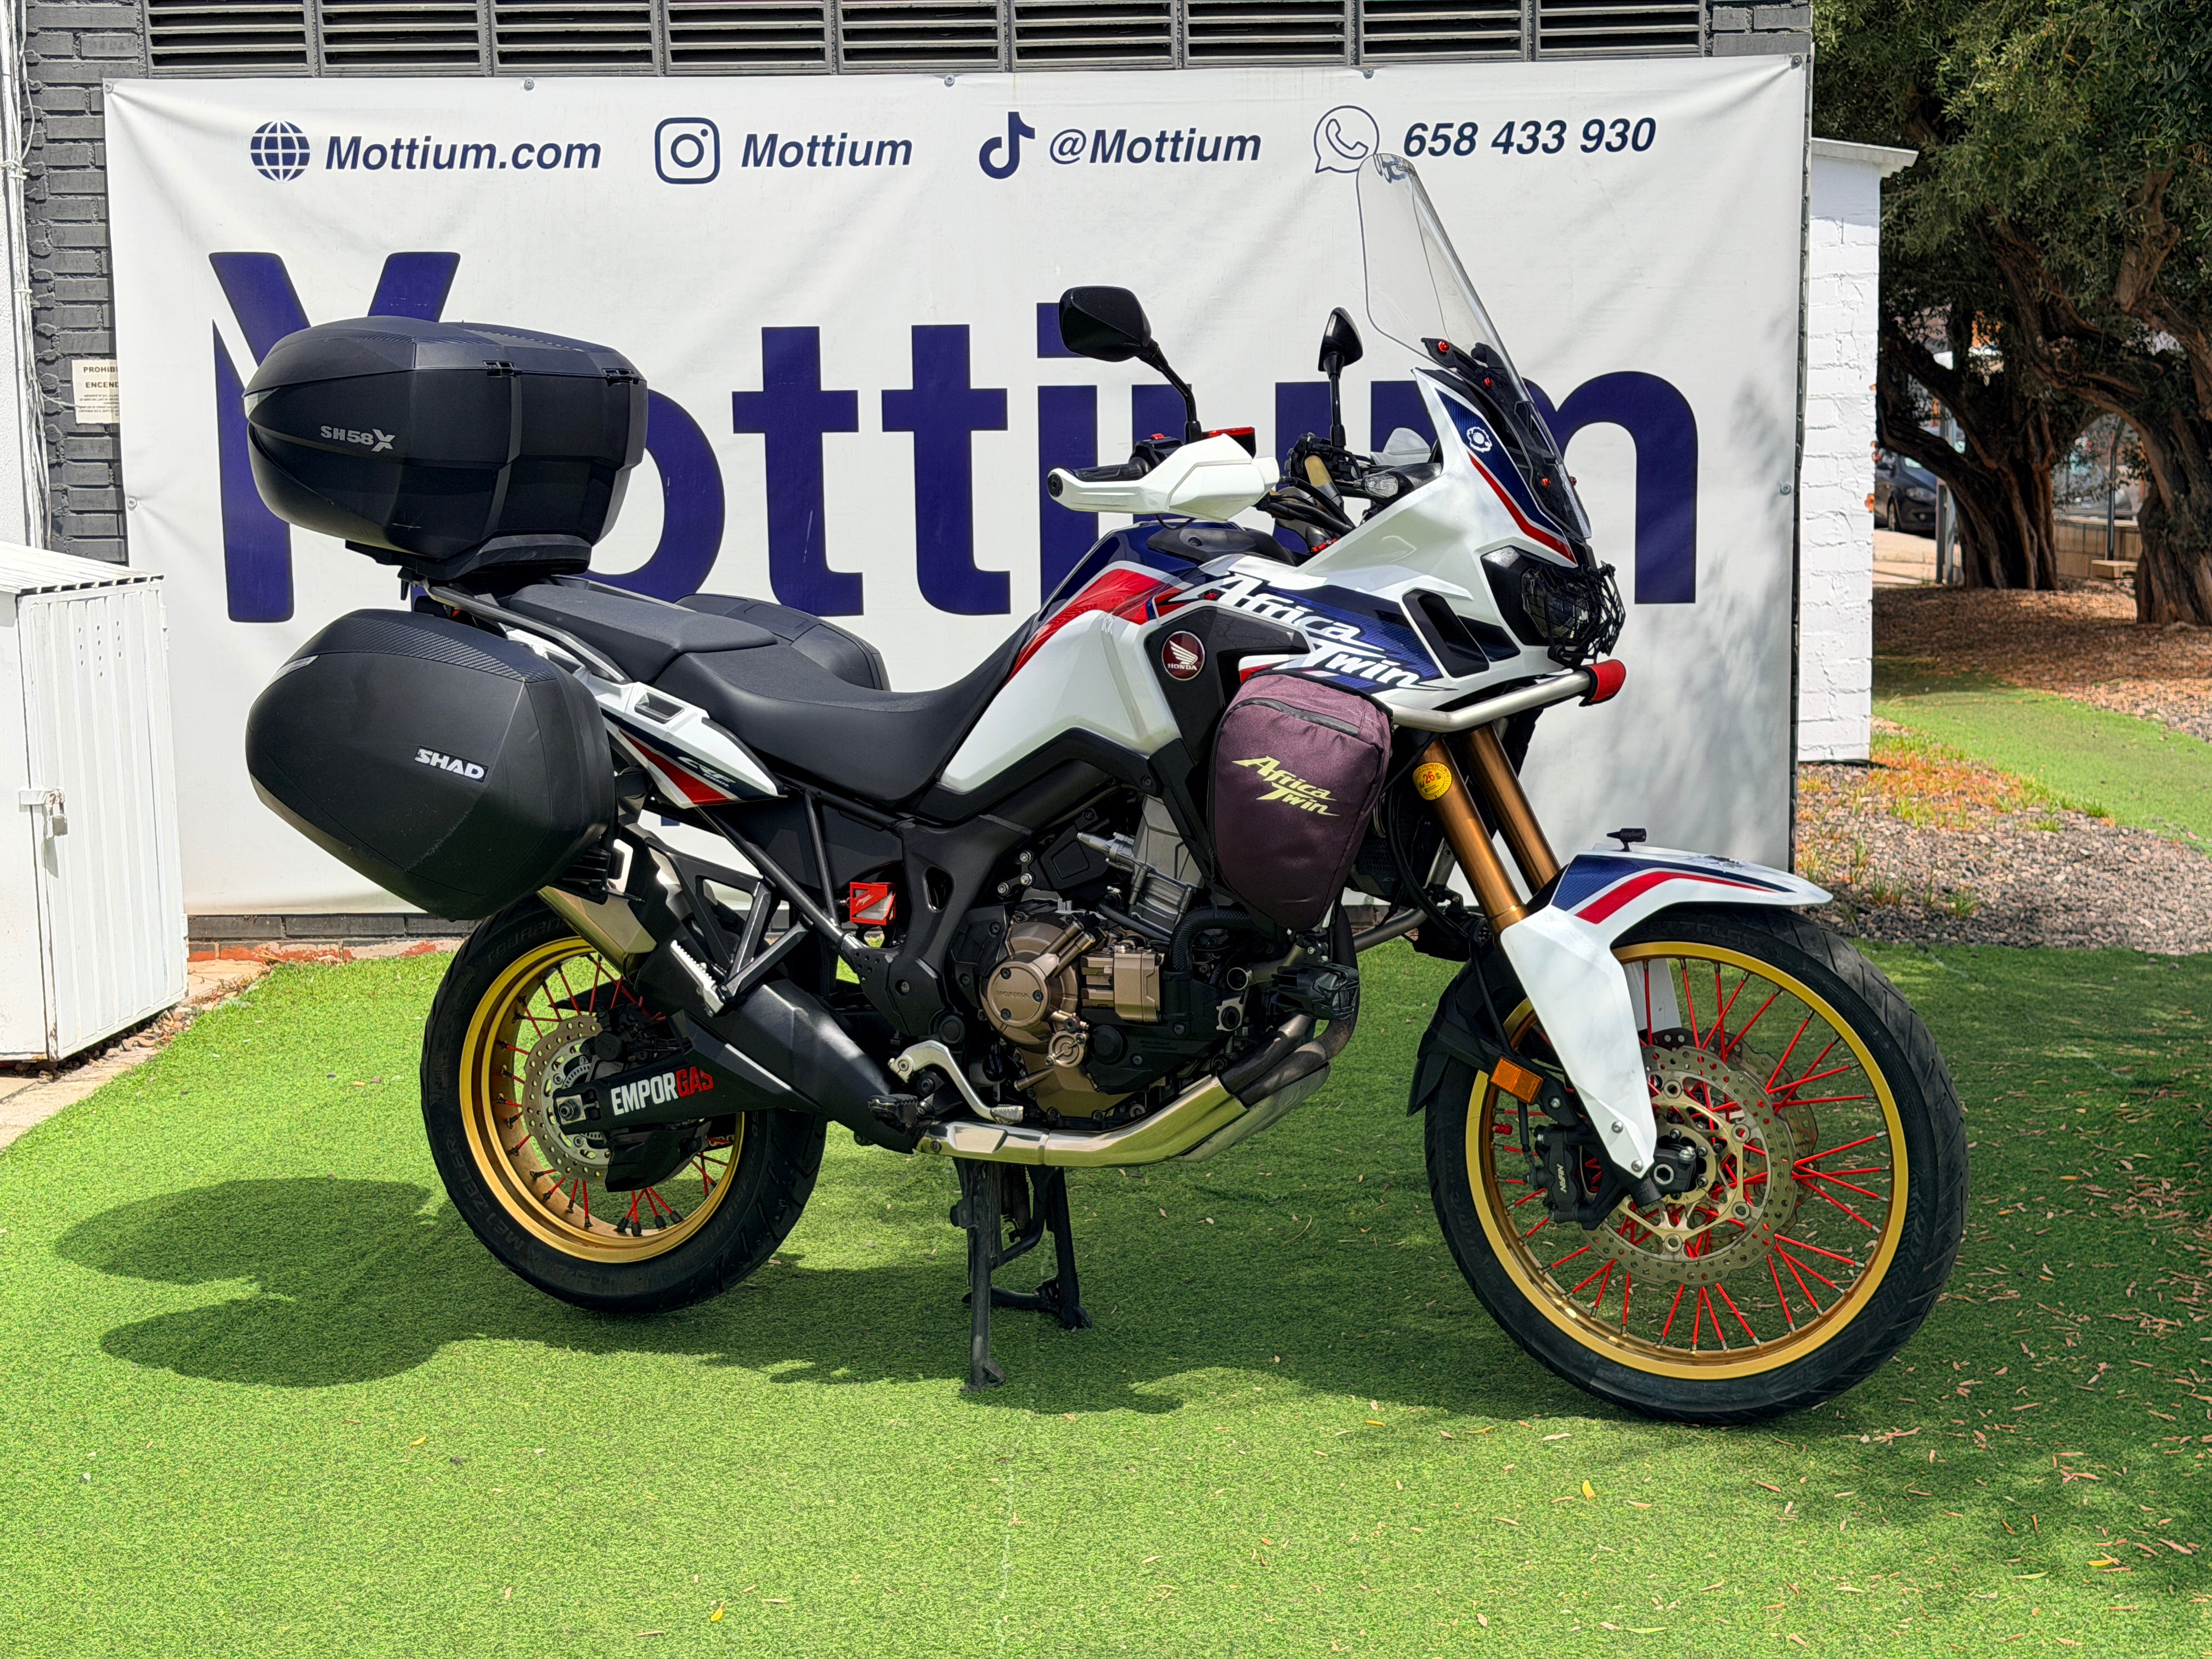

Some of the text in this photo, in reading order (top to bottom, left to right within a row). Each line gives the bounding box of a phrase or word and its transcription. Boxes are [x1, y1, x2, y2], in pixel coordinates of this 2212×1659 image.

[325, 136, 601, 171] Mottium.com
[741, 132, 913, 168] Mottium
[1049, 127, 1261, 165] @Mottium
[1404, 117, 1656, 156] 658 433 930
[320, 425, 396, 452] SH58X
[1169, 571, 1389, 651] Africa
[1167, 663, 1198, 671] HONDA
[1272, 638, 1458, 691] Twin
[414, 748, 484, 779] SHAD
[1231, 755, 1337, 801] Africa
[1423, 771, 1435, 784] 26
[1256, 782, 1340, 816] Twin
[611, 1066, 714, 1116] EMPORGAS
